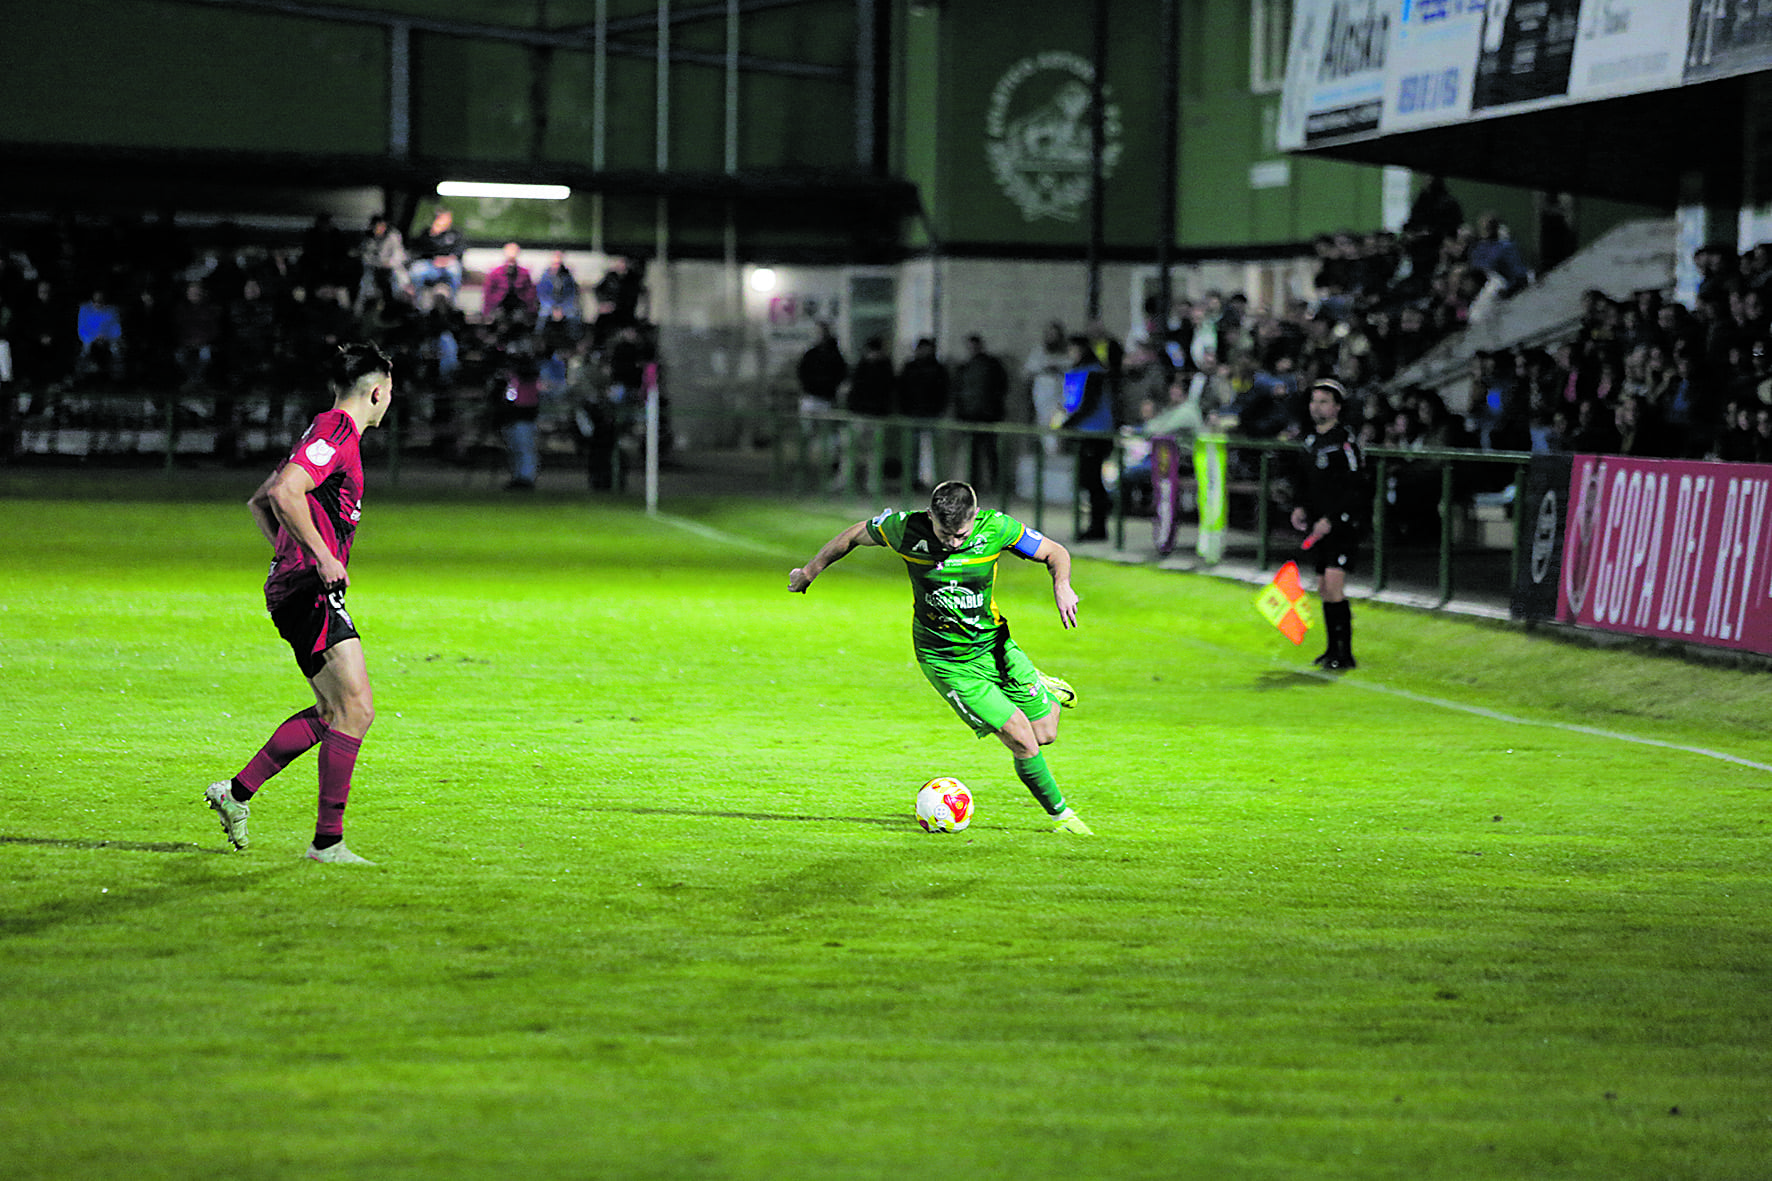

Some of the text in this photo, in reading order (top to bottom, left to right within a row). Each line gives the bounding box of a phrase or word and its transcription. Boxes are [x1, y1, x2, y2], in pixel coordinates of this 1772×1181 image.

[1594, 468, 1769, 641] COPA DEL REY
